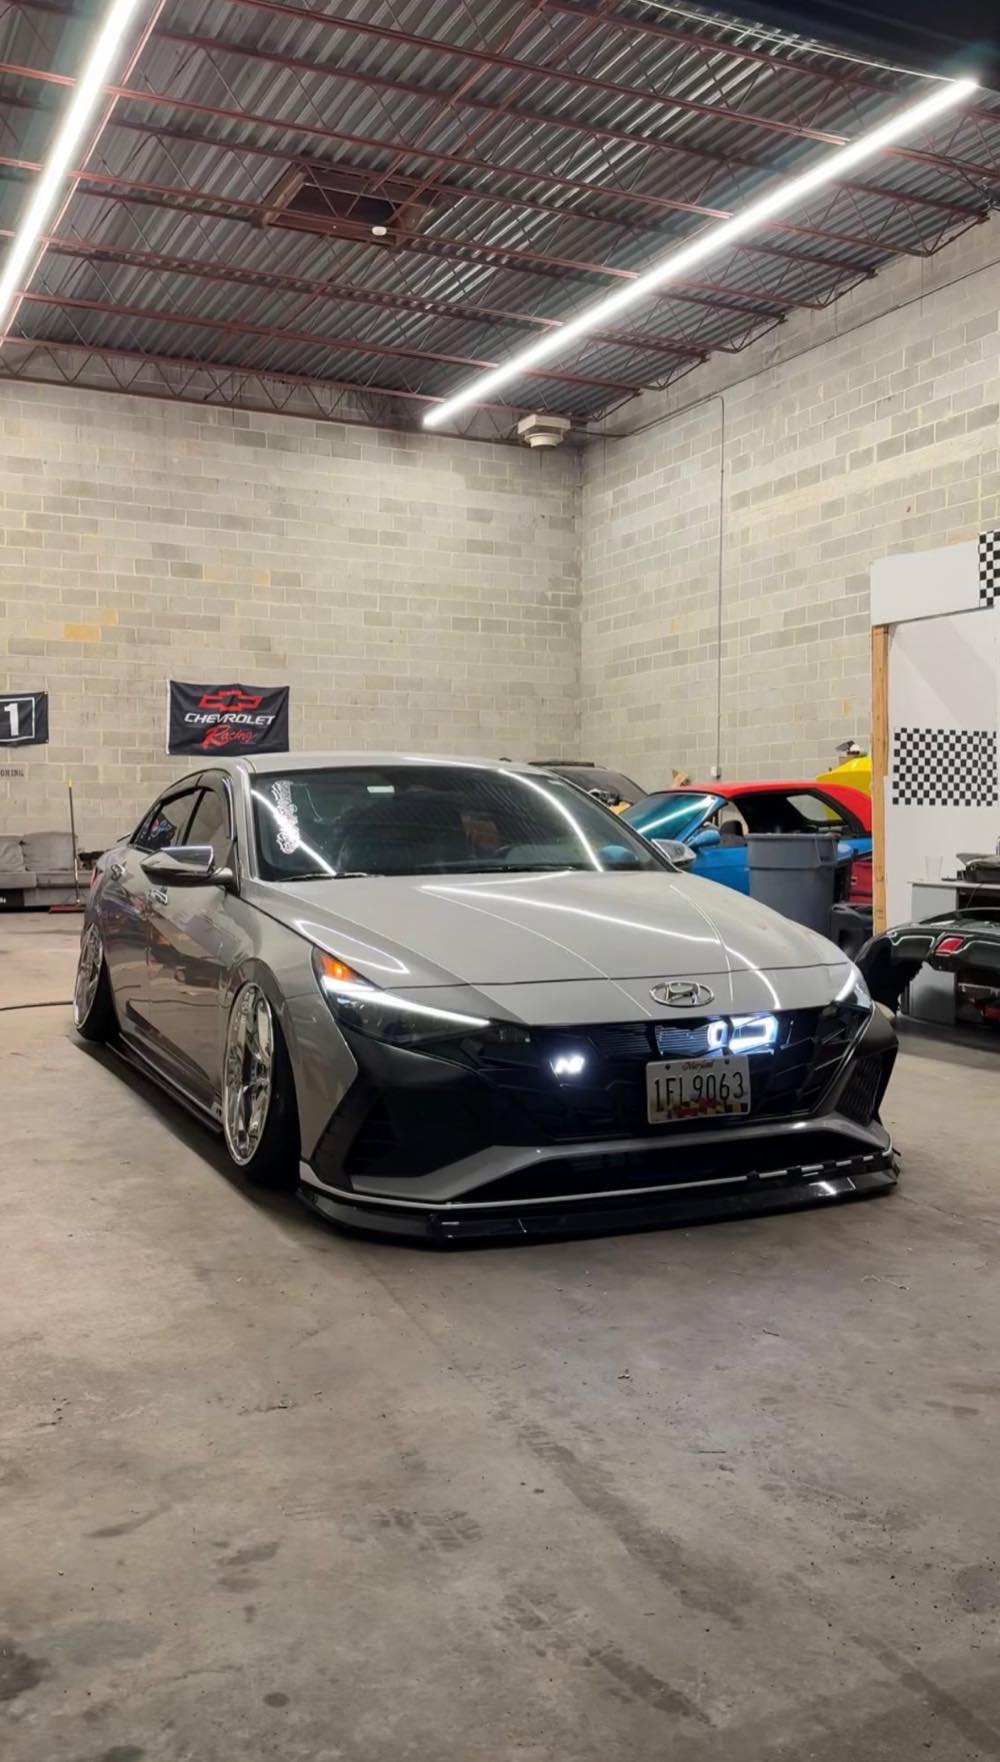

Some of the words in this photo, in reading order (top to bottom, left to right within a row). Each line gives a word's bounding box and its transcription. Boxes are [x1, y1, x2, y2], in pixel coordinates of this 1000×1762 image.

[4, 703, 19, 736] 1
[184, 712, 275, 725] CHEVROLET
[201, 724, 256, 750] Racing
[655, 1071, 744, 1113] 1FL9063
